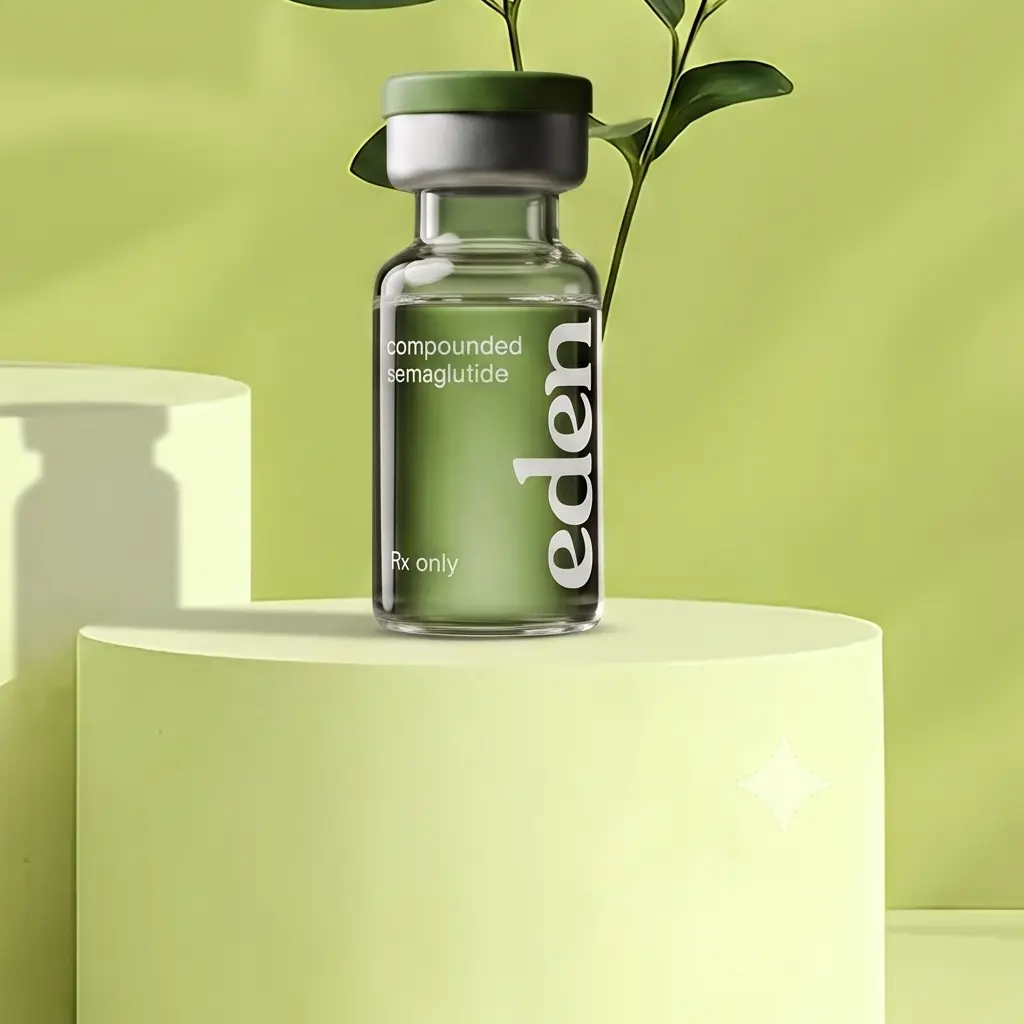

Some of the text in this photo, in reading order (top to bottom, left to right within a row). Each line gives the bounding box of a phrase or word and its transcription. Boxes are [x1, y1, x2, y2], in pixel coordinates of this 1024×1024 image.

[386, 335, 522, 361] compounded
[387, 364, 509, 389] semaglutide
[512, 317, 593, 589] eden
[391, 550, 458, 578] Rx only
